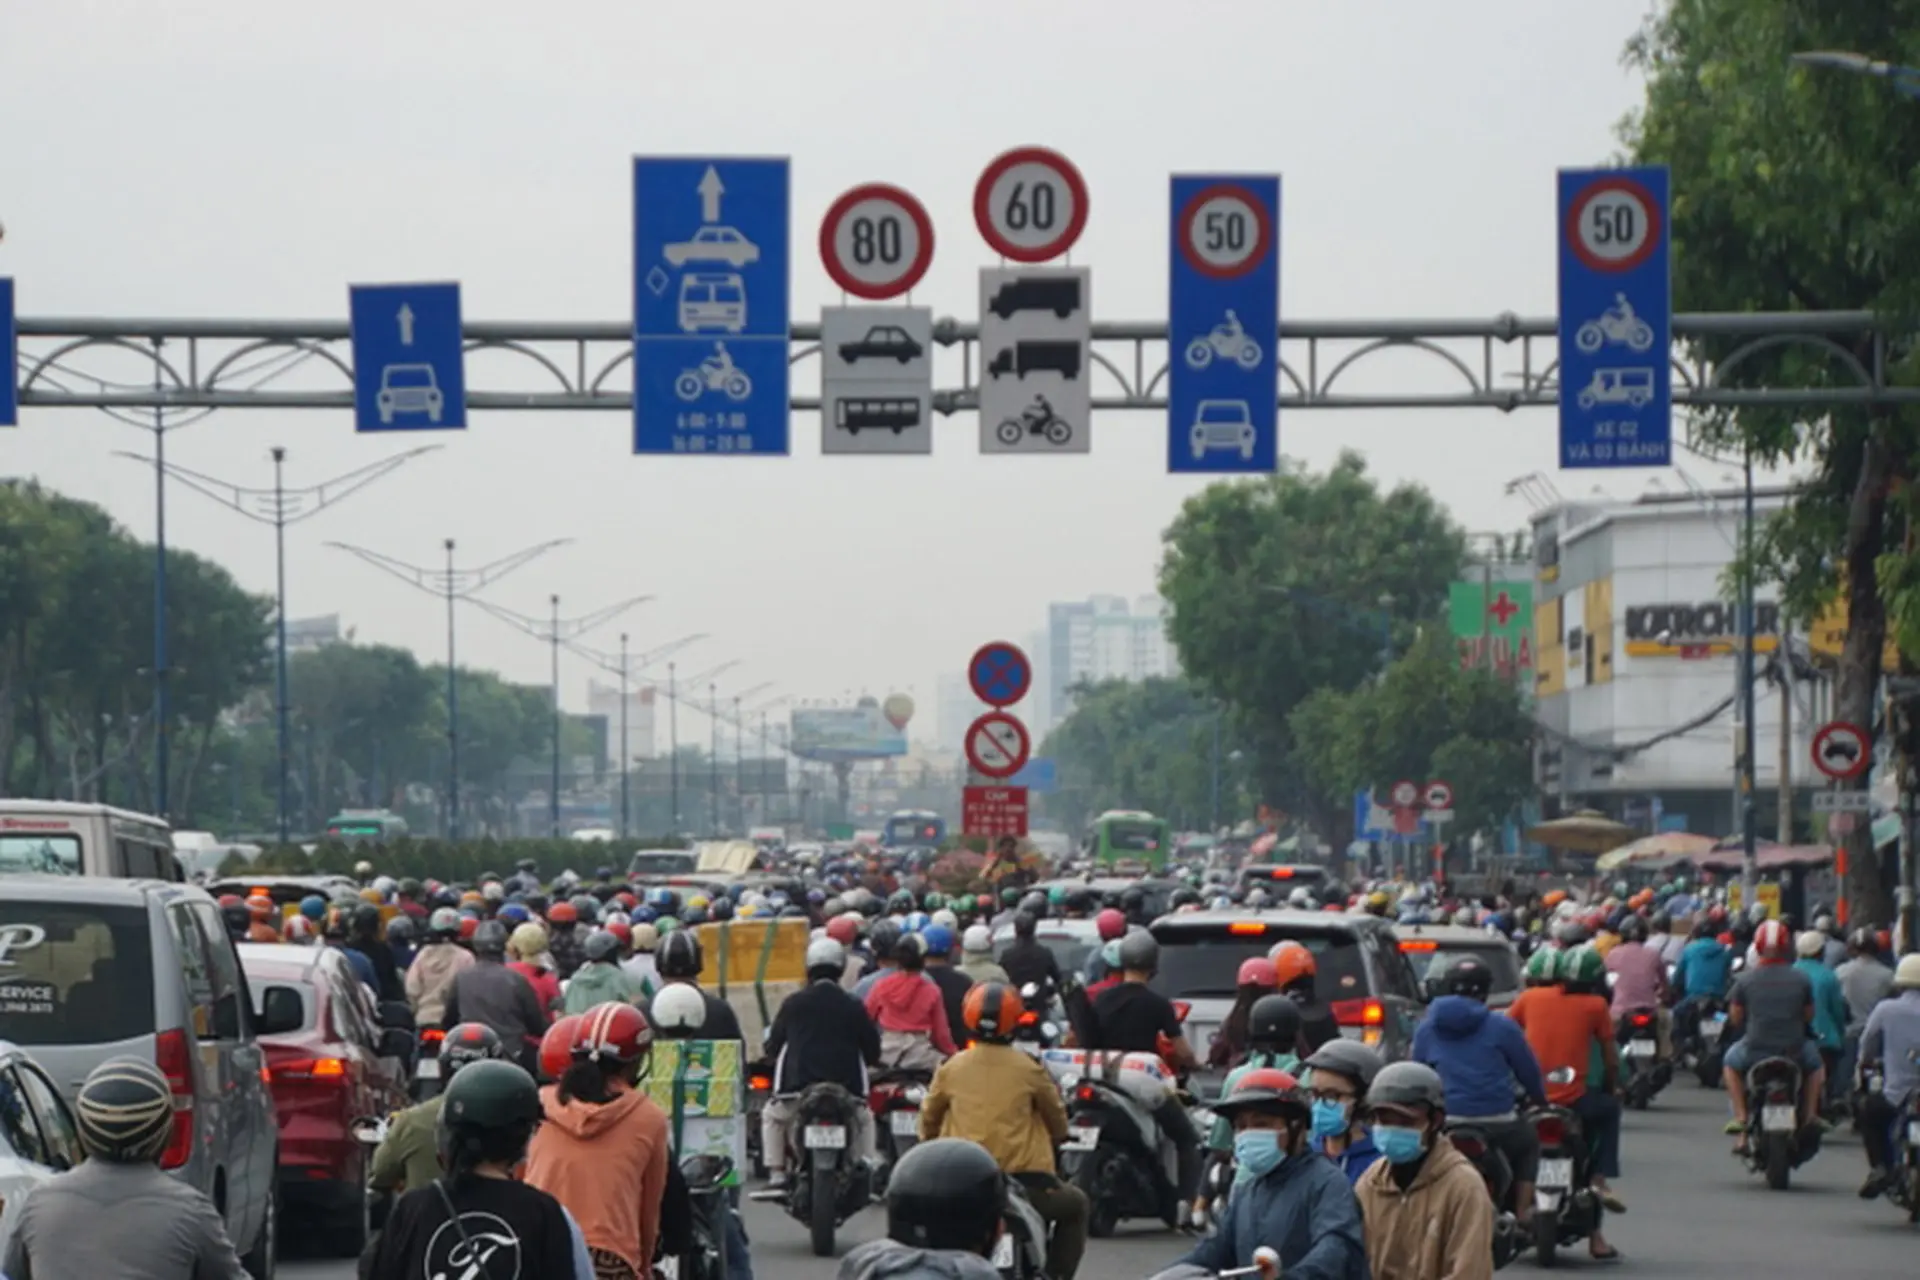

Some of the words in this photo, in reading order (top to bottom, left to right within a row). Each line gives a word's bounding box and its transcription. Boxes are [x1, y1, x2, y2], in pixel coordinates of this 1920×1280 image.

[1005, 181, 1055, 231] 60
[1593, 204, 1634, 245] 50
[851, 216, 902, 266] 80
[1205, 212, 1245, 252] 50
